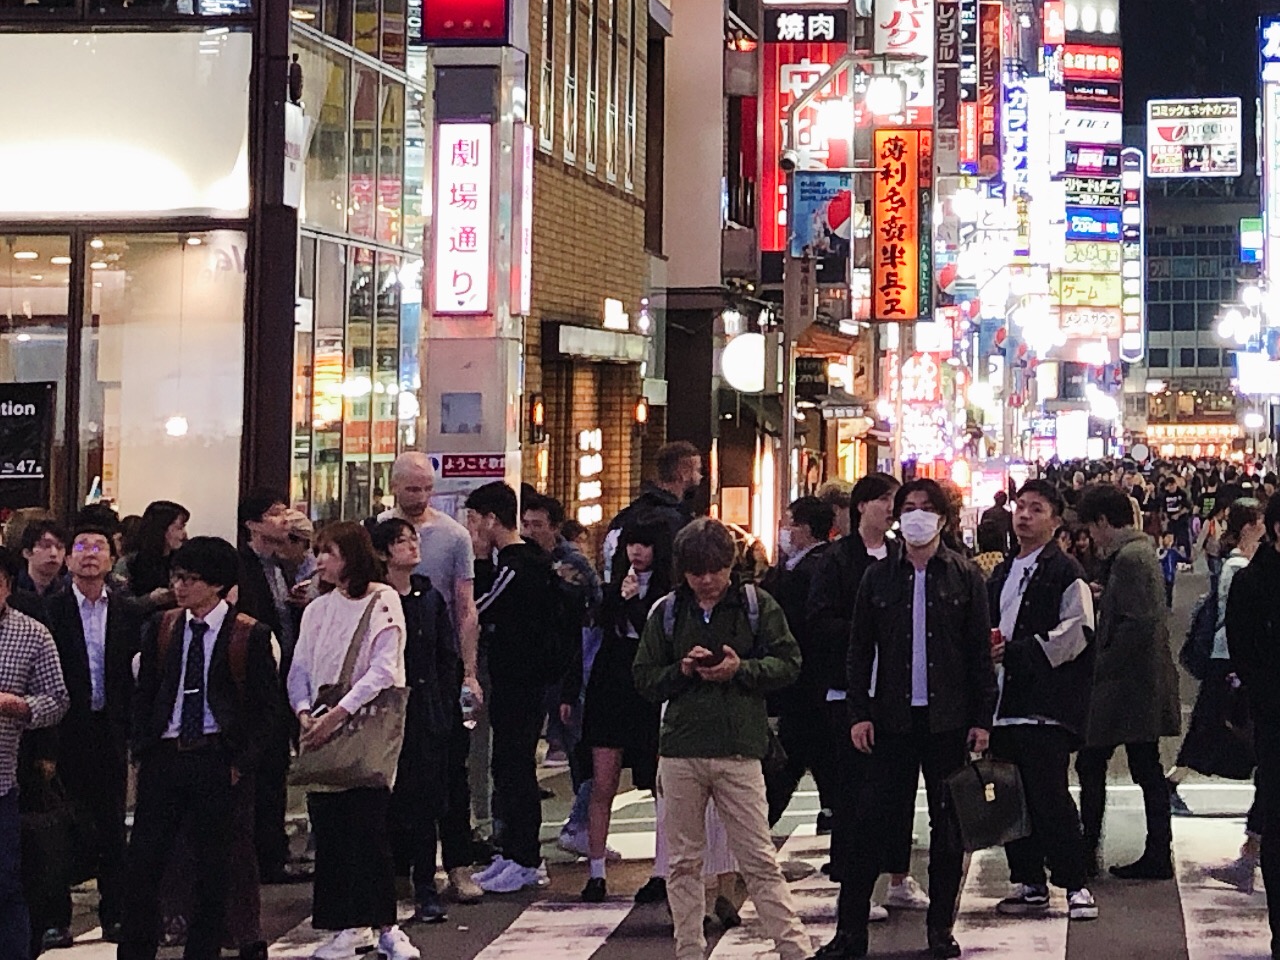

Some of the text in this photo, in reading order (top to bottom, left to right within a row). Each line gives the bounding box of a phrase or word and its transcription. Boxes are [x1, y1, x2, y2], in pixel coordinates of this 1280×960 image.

[777, 12, 835, 41] 焼肉
[449, 138, 480, 297] 劇場通り
